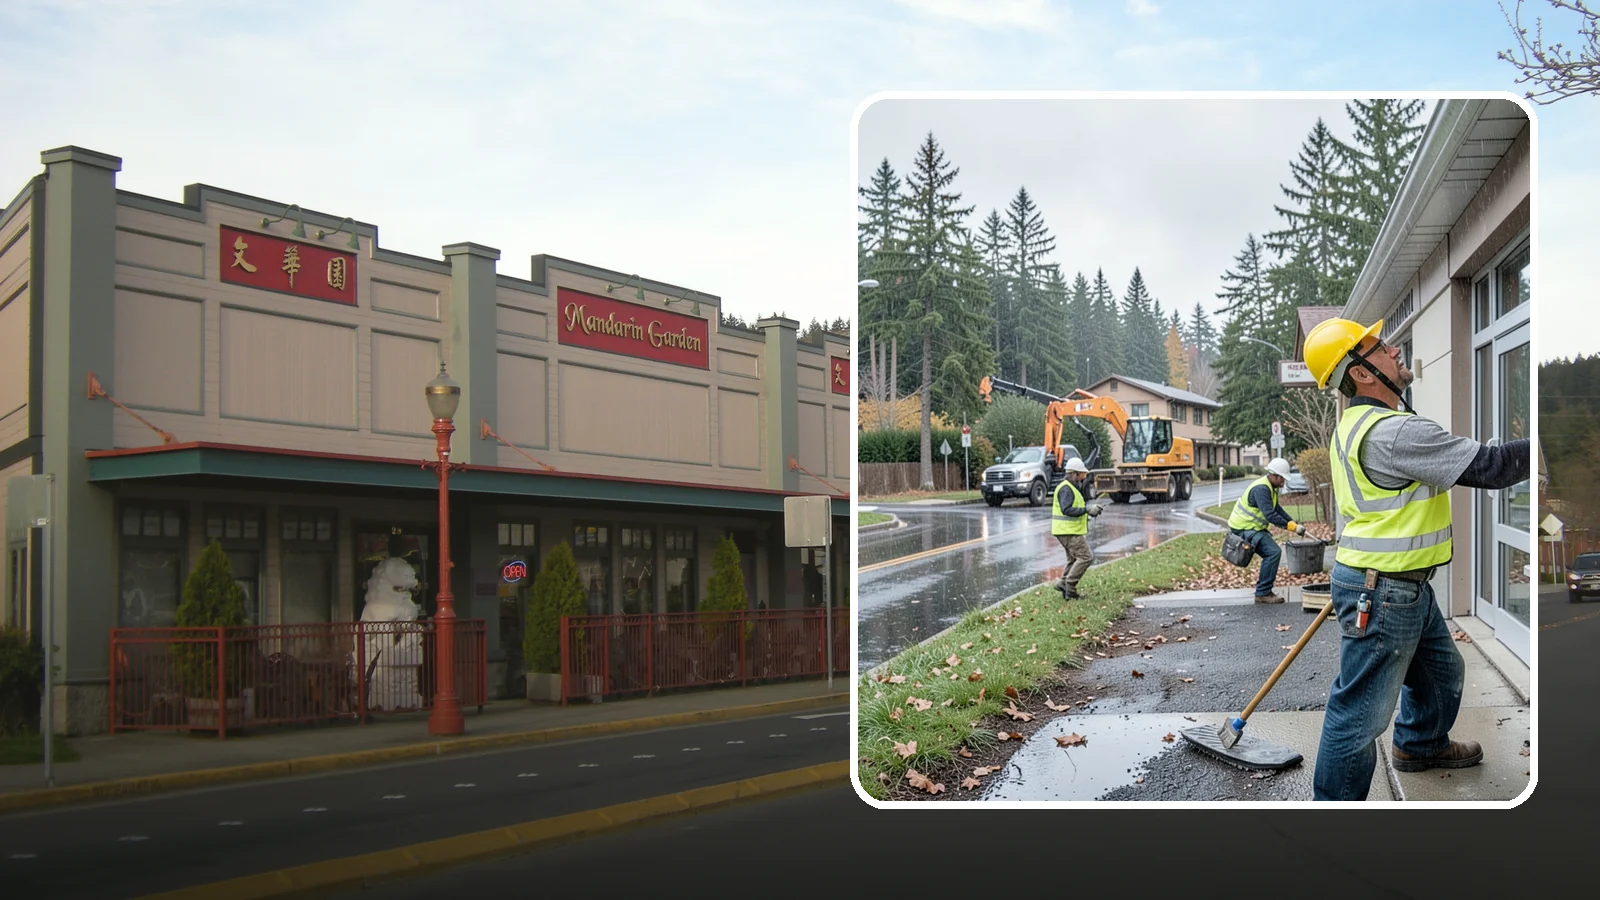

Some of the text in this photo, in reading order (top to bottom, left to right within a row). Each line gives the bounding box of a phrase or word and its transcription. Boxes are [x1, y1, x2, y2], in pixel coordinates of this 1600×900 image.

[231, 236, 346, 290] 文華園
[565, 302, 701, 352] Mandarin Garden
[835, 363, 846, 386] 文
[503, 565, 527, 578] OPEN
